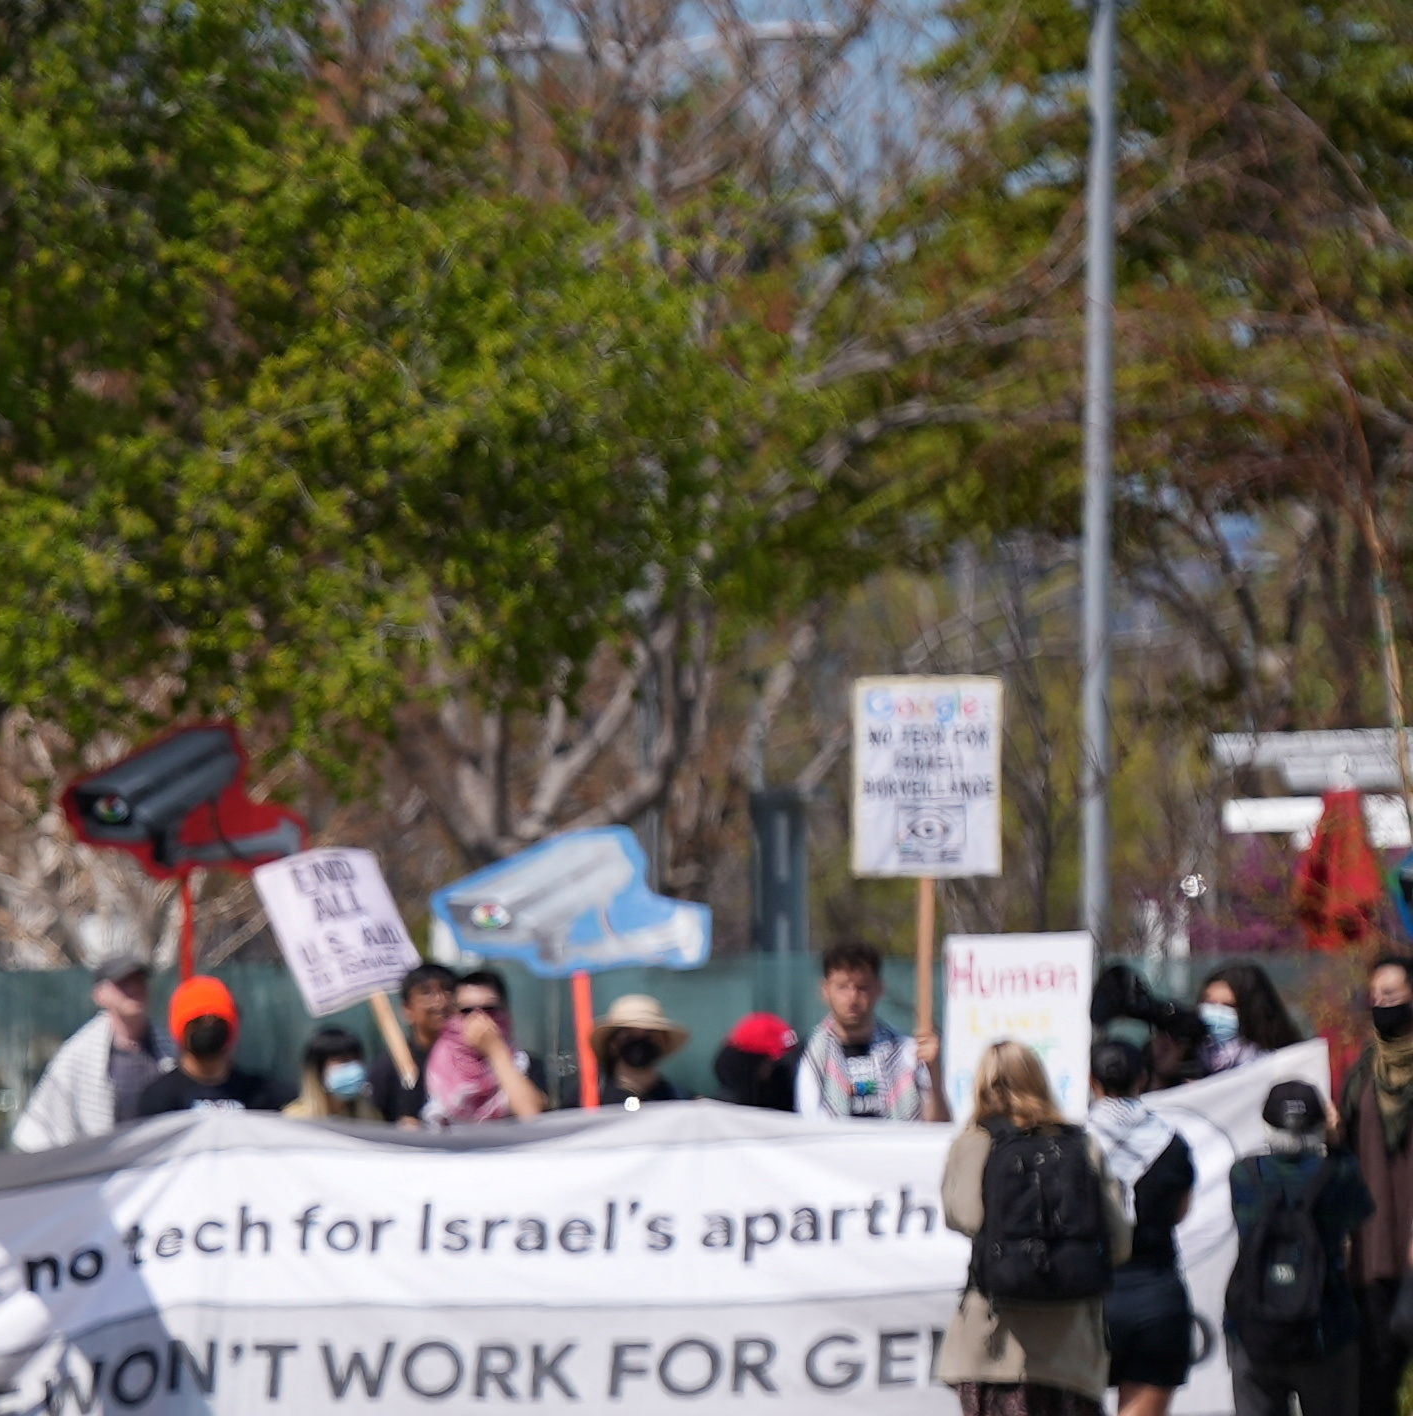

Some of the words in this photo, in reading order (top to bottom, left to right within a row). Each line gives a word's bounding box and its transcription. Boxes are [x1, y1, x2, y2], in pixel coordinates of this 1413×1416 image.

[291, 858, 357, 897] END
[947, 949, 1078, 999] Human
[26, 1249, 103, 1293] no
[123, 1204, 271, 1265] tech
[295, 1203, 395, 1252] for
[420, 1199, 674, 1253] Israel's
[701, 1184, 939, 1265] aparth
[319, 1339, 579, 1399] WORK
[608, 1336, 778, 1397] FOR
